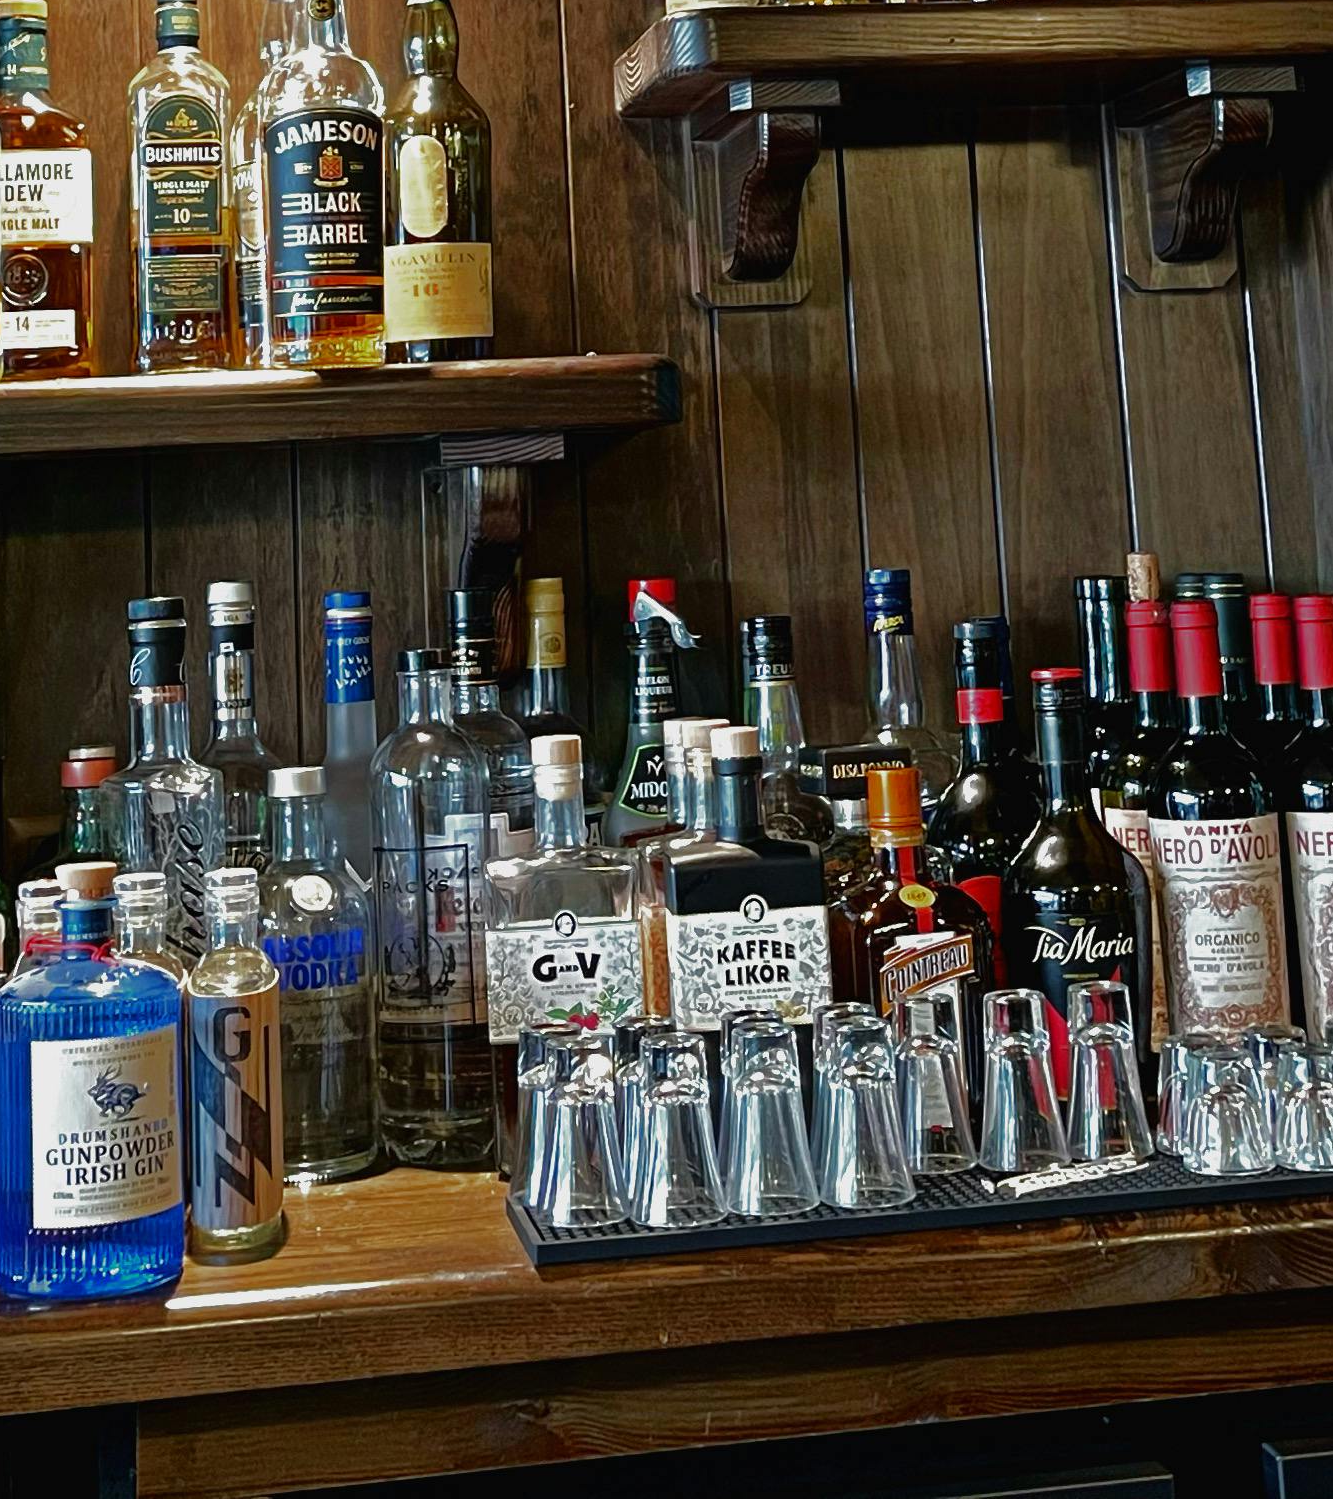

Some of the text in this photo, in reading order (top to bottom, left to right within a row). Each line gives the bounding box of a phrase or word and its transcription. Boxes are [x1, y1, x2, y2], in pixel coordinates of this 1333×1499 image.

[275, 121, 378, 155] JAMESON
[146, 147, 219, 163] BUSHMILLS
[0, 163, 74, 181] LLAMORE
[233, 172, 256, 191] POW
[4, 185, 43, 202] DEW
[299, 192, 361, 213] BLACK
[1, 218, 59, 231] NGLE MALT
[174, 208, 190, 224] 10
[296, 224, 368, 245] BARREL
[413, 284, 439, 298] 16
[15, 316, 30, 332] 14
[637, 675, 669, 685] MELON
[635, 686, 673, 696] LIQUEUR
[630, 782, 668, 800] MIDO
[1113, 826, 1148, 854] NER
[1153, 838, 1203, 865] NERO
[382, 880, 450, 893] PACKS
[1024, 926, 1134, 966] Tia Maria
[1195, 932, 1260, 946] ORGANICO
[717, 940, 796, 965] KAFFEE
[277, 958, 358, 992] VODKA
[725, 960, 791, 986] LIKÖR
[884, 943, 969, 1001] COINTREAU
[1194, 961, 1265, 973] NERO D'AVOLA
[58, 1118, 169, 1145] DRUMSHANBO
[46, 1130, 174, 1166] GUNPOWDER
[66, 1156, 165, 1186] IRISH GIN
